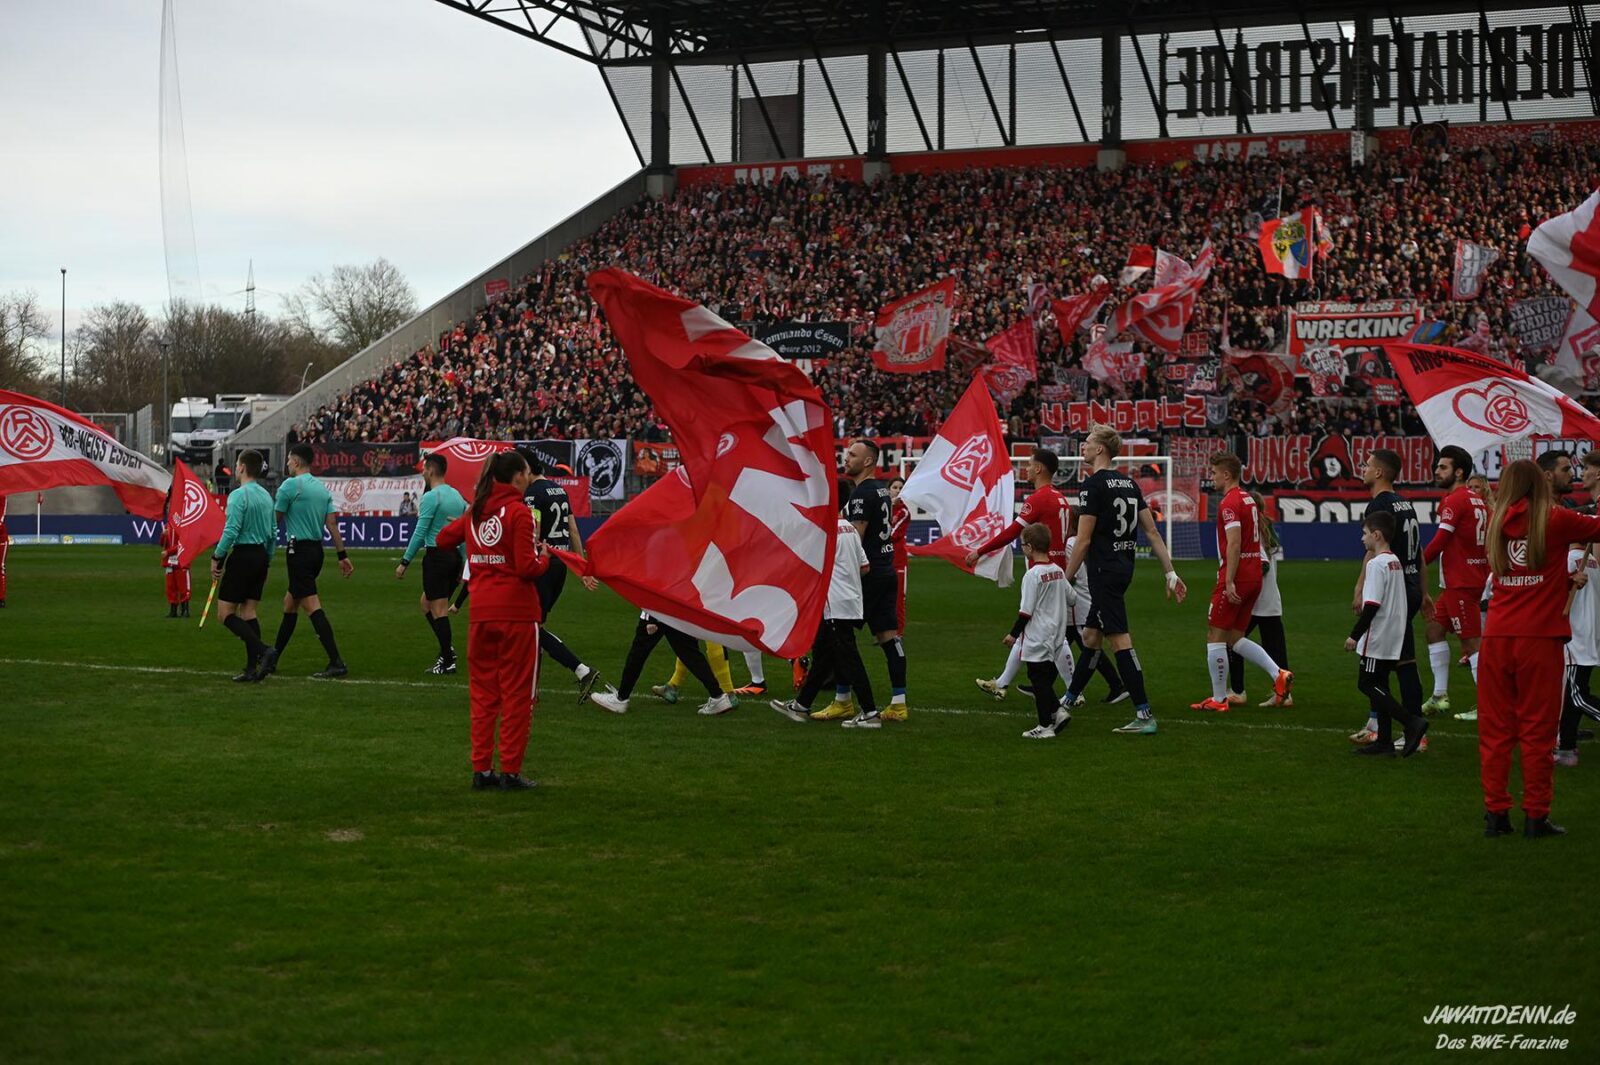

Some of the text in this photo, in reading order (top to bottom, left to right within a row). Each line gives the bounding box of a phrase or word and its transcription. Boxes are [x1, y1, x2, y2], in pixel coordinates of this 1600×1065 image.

[814, 328, 844, 348] Essen
[1295, 316, 1415, 340] WRECKING
[1241, 434, 1313, 484] JUNGE
[547, 501, 570, 539] 23
[879, 502, 893, 541] 3
[1112, 496, 1138, 537] 37
[1402, 518, 1420, 562] 10
